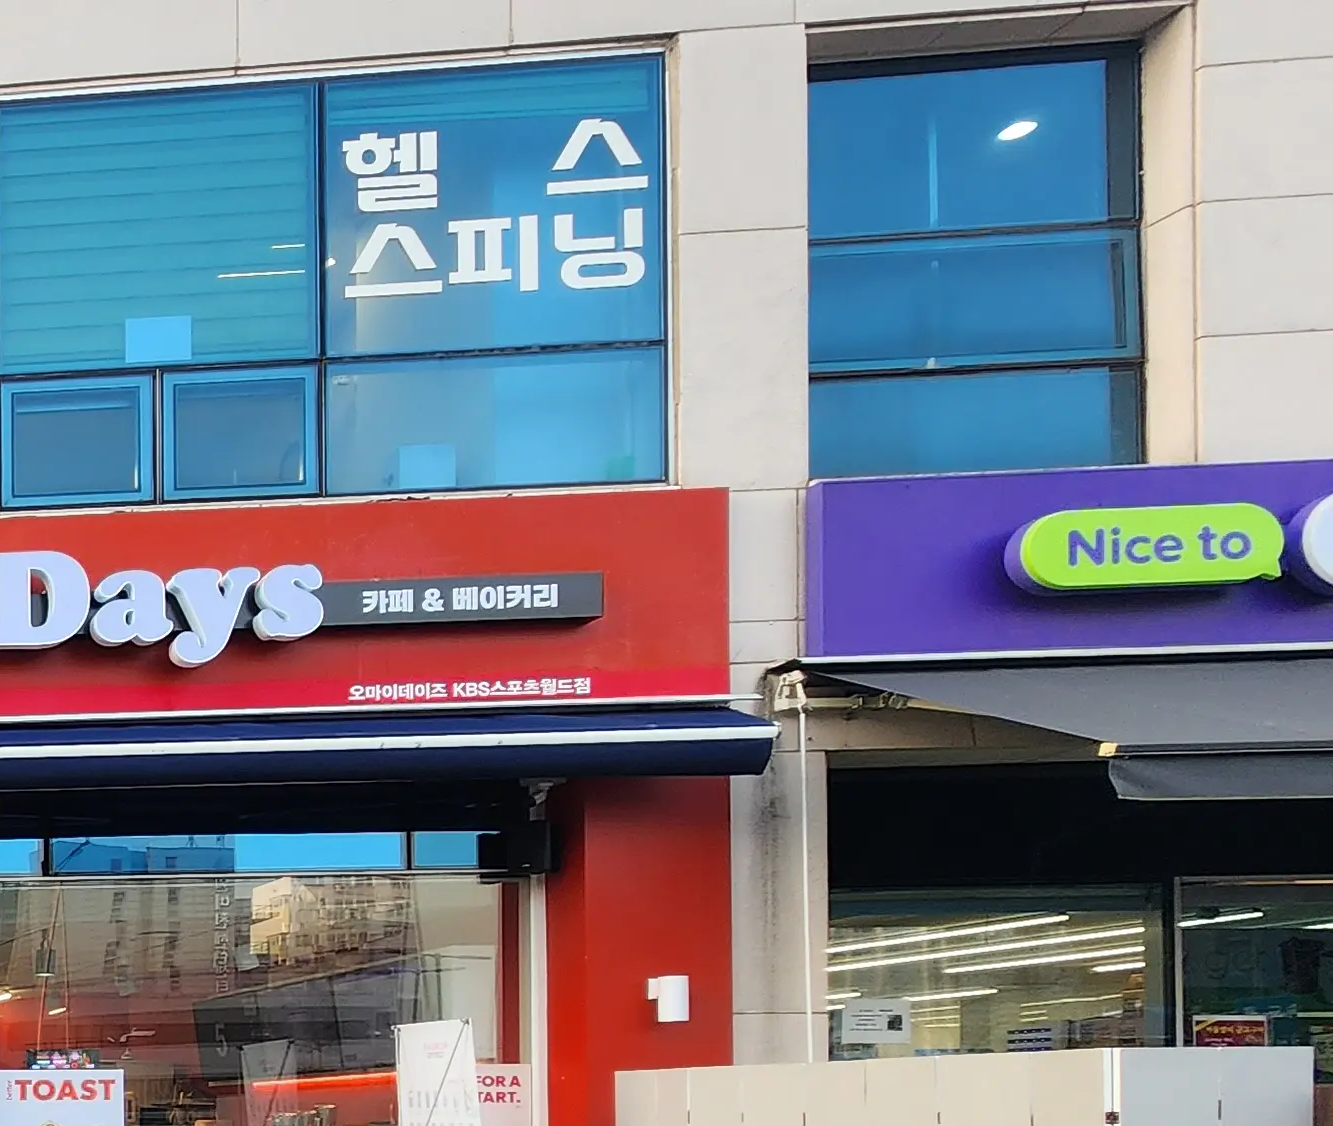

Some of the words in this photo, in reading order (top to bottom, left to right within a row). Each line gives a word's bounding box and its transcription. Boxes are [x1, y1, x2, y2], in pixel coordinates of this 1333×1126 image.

[341, 118, 649, 212] 헬스
[344, 208, 646, 299] 스피닝
[1067, 526, 1184, 567] Nice
[1200, 525, 1252, 560] to
[362, 589, 414, 613] 카페
[422, 588, 444, 612] &
[452, 584, 559, 611] 베이커리
[348, 683, 448, 701] 오마이데이즈
[453, 677, 591, 698] KBS스포츠월드점
[14, 1079, 116, 1101] TOAST
[509, 1075, 521, 1087] A
[478, 1091, 521, 1103] TART.
